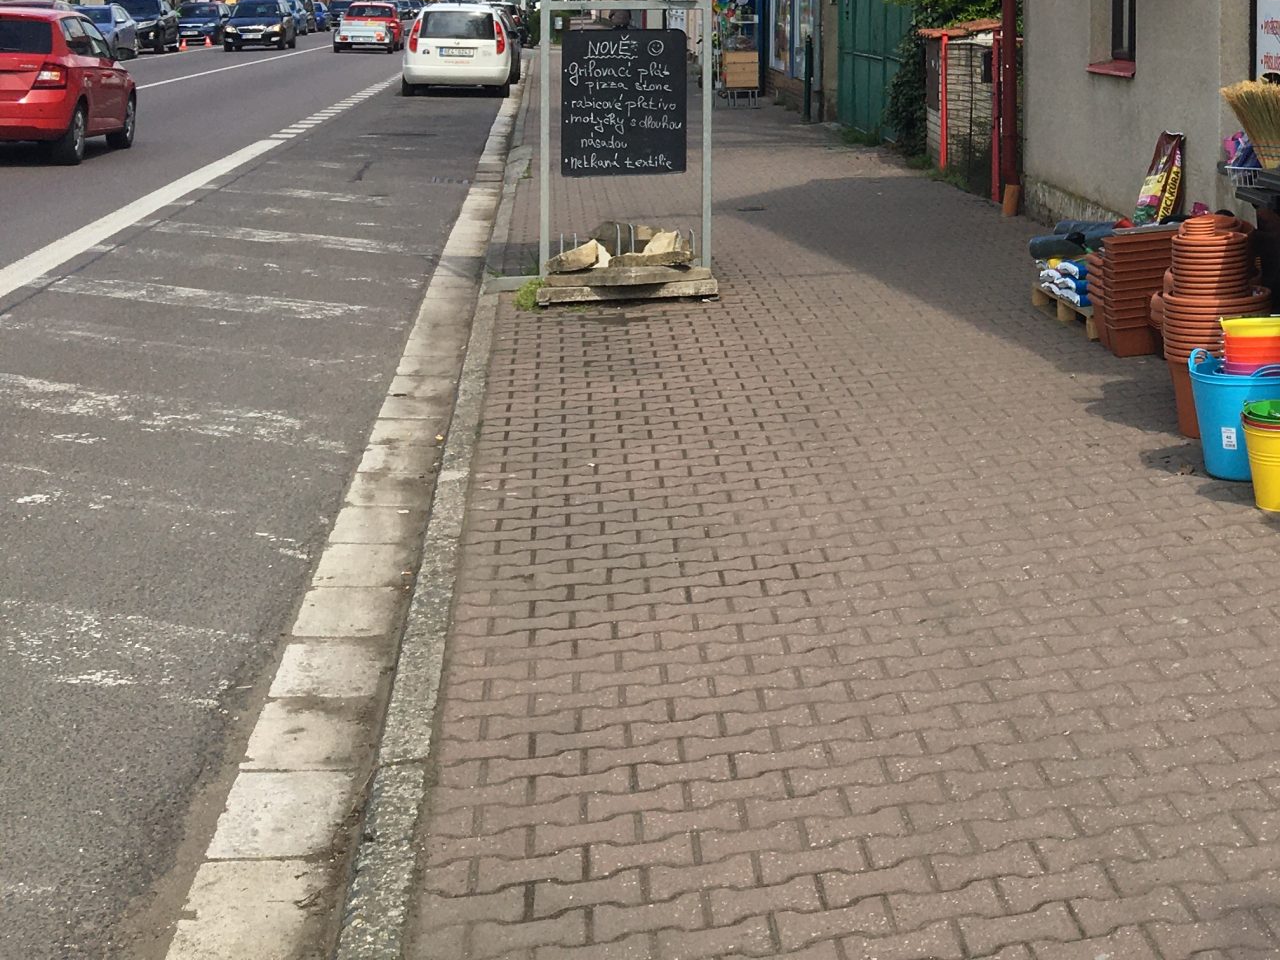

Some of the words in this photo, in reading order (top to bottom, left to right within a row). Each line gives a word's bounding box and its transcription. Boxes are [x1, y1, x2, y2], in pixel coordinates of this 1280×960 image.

[637, 62, 670, 83] plát
[585, 81, 629, 95] pizza
[635, 80, 673, 92] stone
[625, 96, 677, 117] pletivo
[570, 113, 625, 135] motyčky
[630, 119, 636, 127] s
[639, 115, 682, 130] dlouhou
[580, 132, 628, 149] násadou
[625, 153, 673, 170] textilie
